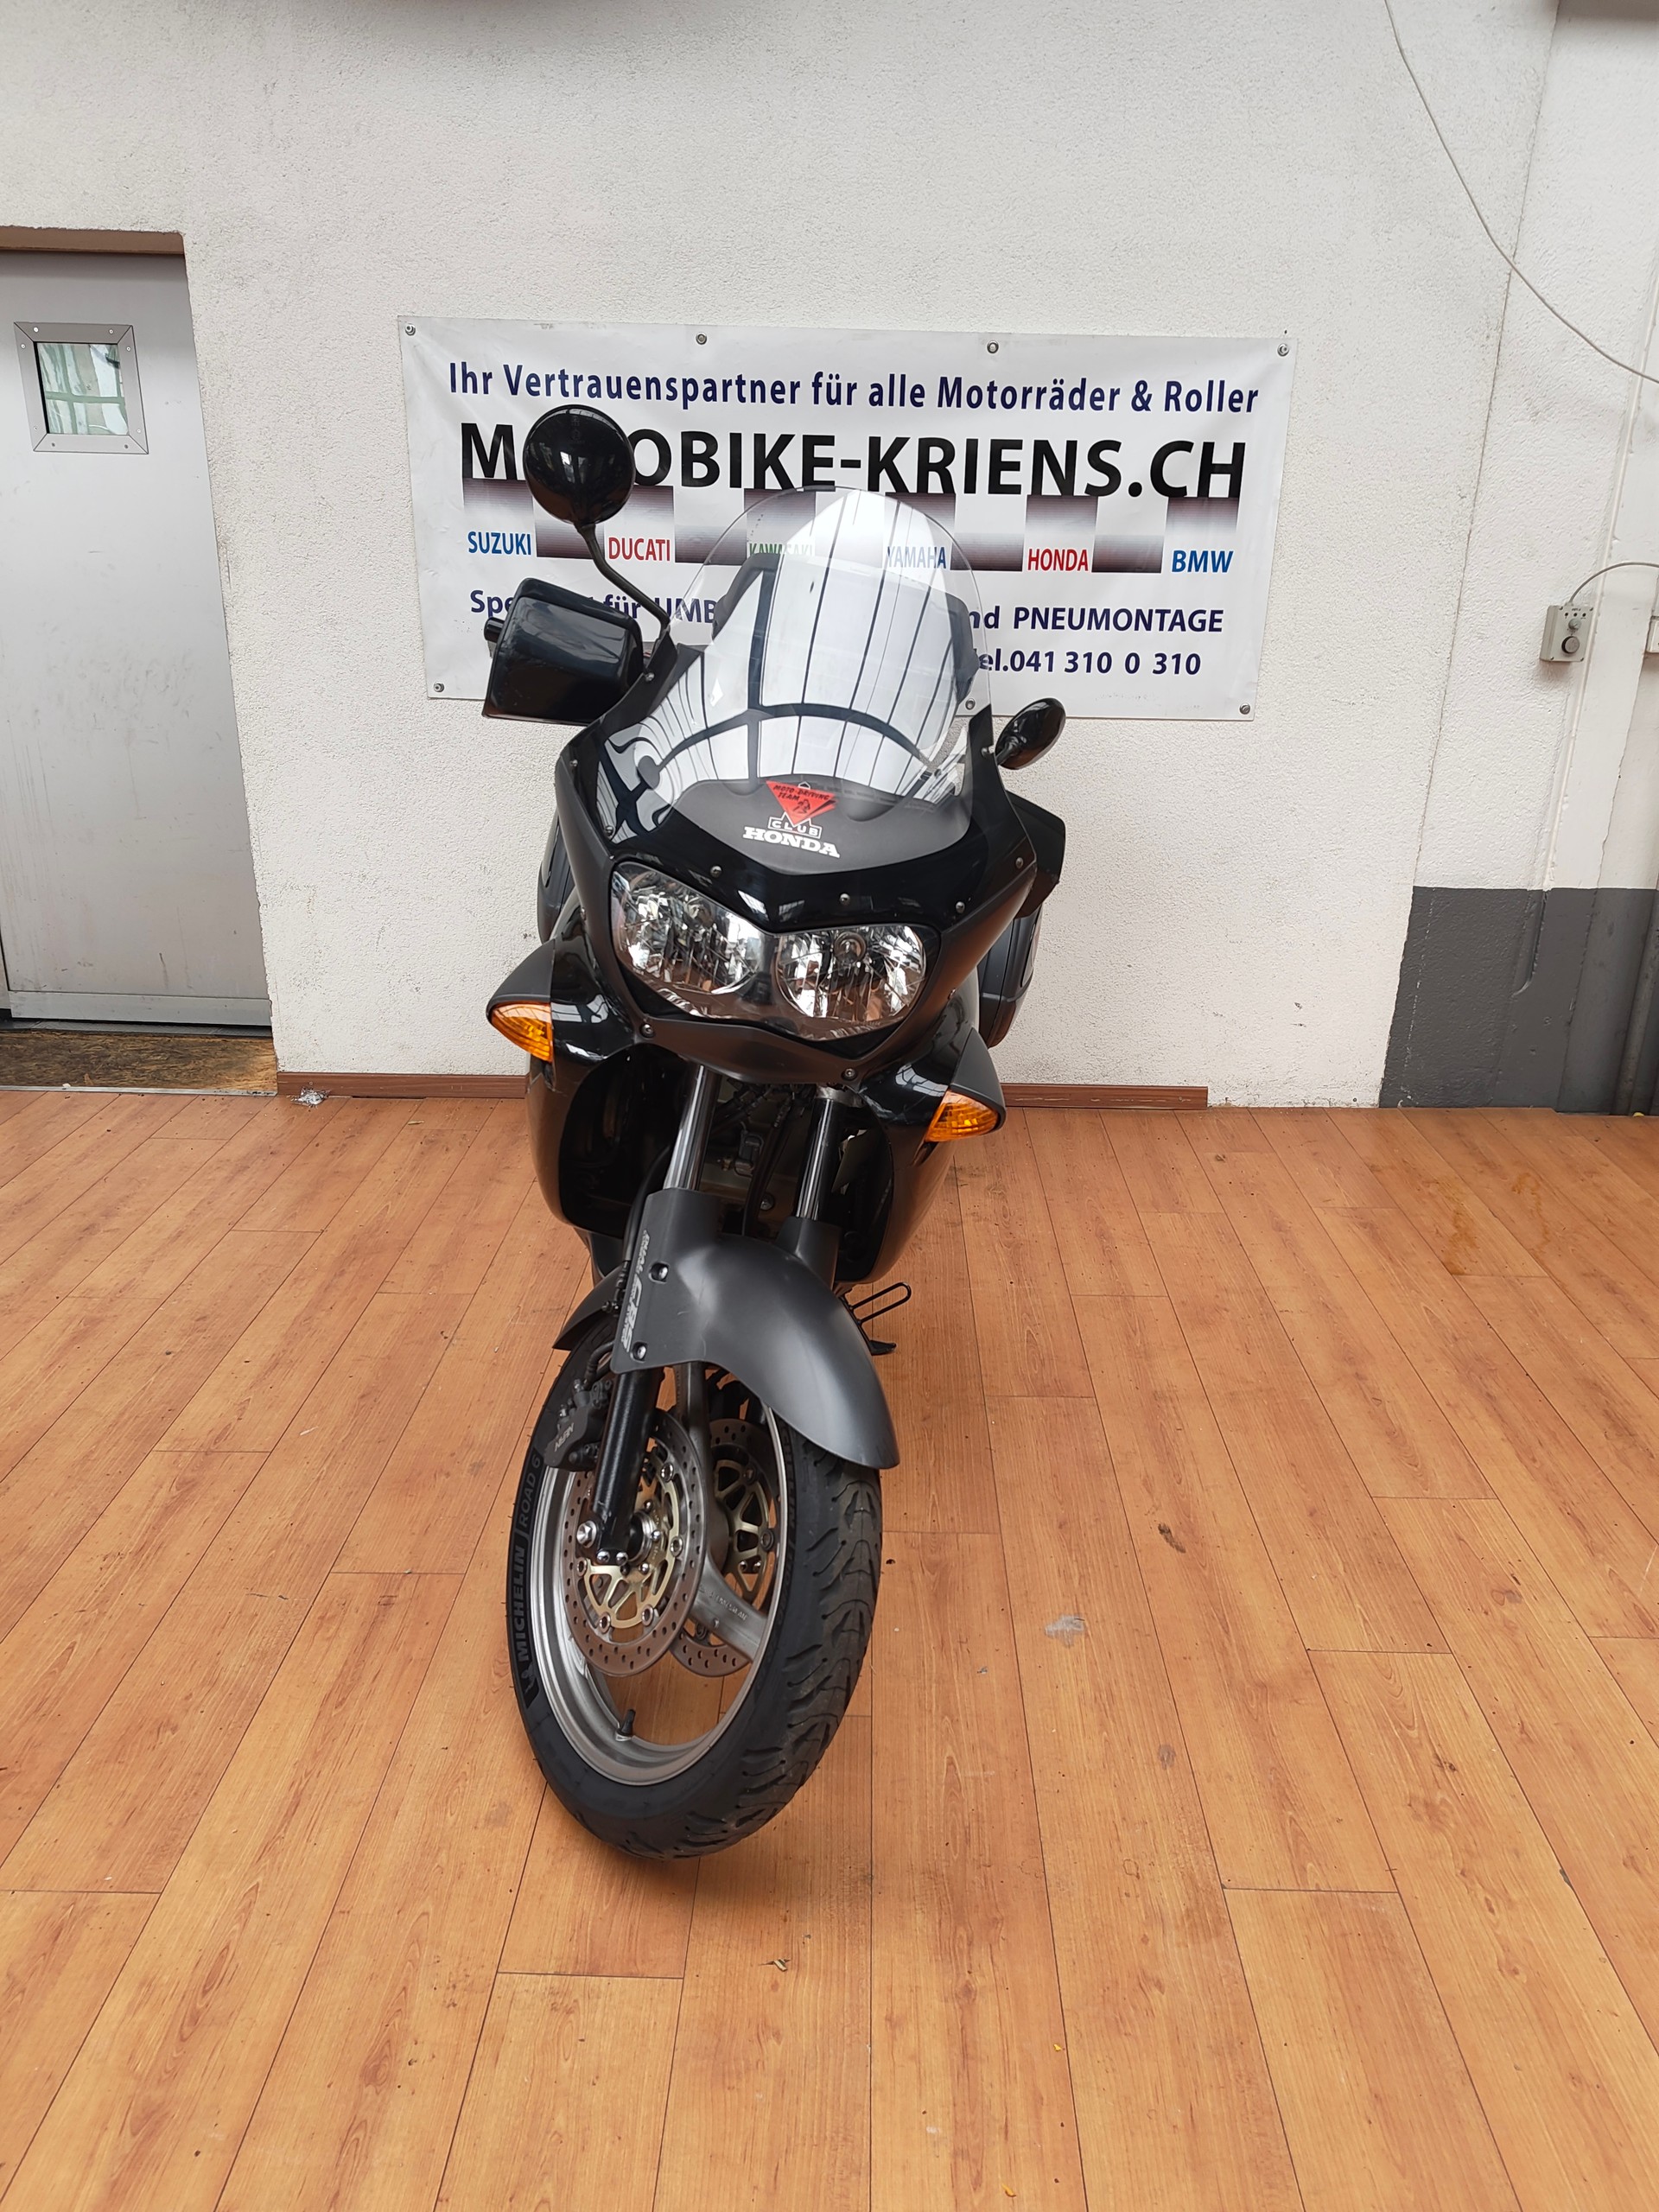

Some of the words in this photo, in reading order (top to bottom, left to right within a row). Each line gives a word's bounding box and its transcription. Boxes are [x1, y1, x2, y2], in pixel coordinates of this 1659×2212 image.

[449, 361, 493, 395] Ihr
[503, 364, 800, 410] Vertrauenspartner
[811, 372, 857, 406] für
[868, 374, 925, 408] alle
[938, 377, 1121, 411] Motorräder
[1131, 379, 1153, 411] &
[1165, 379, 1259, 413] Roller
[461, 423, 1246, 499] MOBIKE-KRIENS.CH
[467, 531, 531, 556] SUZUKI
[608, 537, 671, 562] DUCATI
[887, 545, 947, 569] YAMAHA
[1027, 548, 1089, 572] HONDA
[1171, 550, 1234, 573] BMW
[969, 606, 1001, 629] nd
[1013, 607, 1224, 632] PNEUMONTAGE
[1064, 651, 1112, 673] 310
[1124, 652, 1141, 675] 0
[1152, 653, 1201, 676] 310
[778, 792, 799, 802] TEAM
[742, 826, 841, 858] HONDA
[772, 820, 818, 836] CLUB
[531, 1453, 541, 1469] 6
[518, 1471, 537, 1529] ROAD
[513, 1545, 531, 1663] MICHELIN
